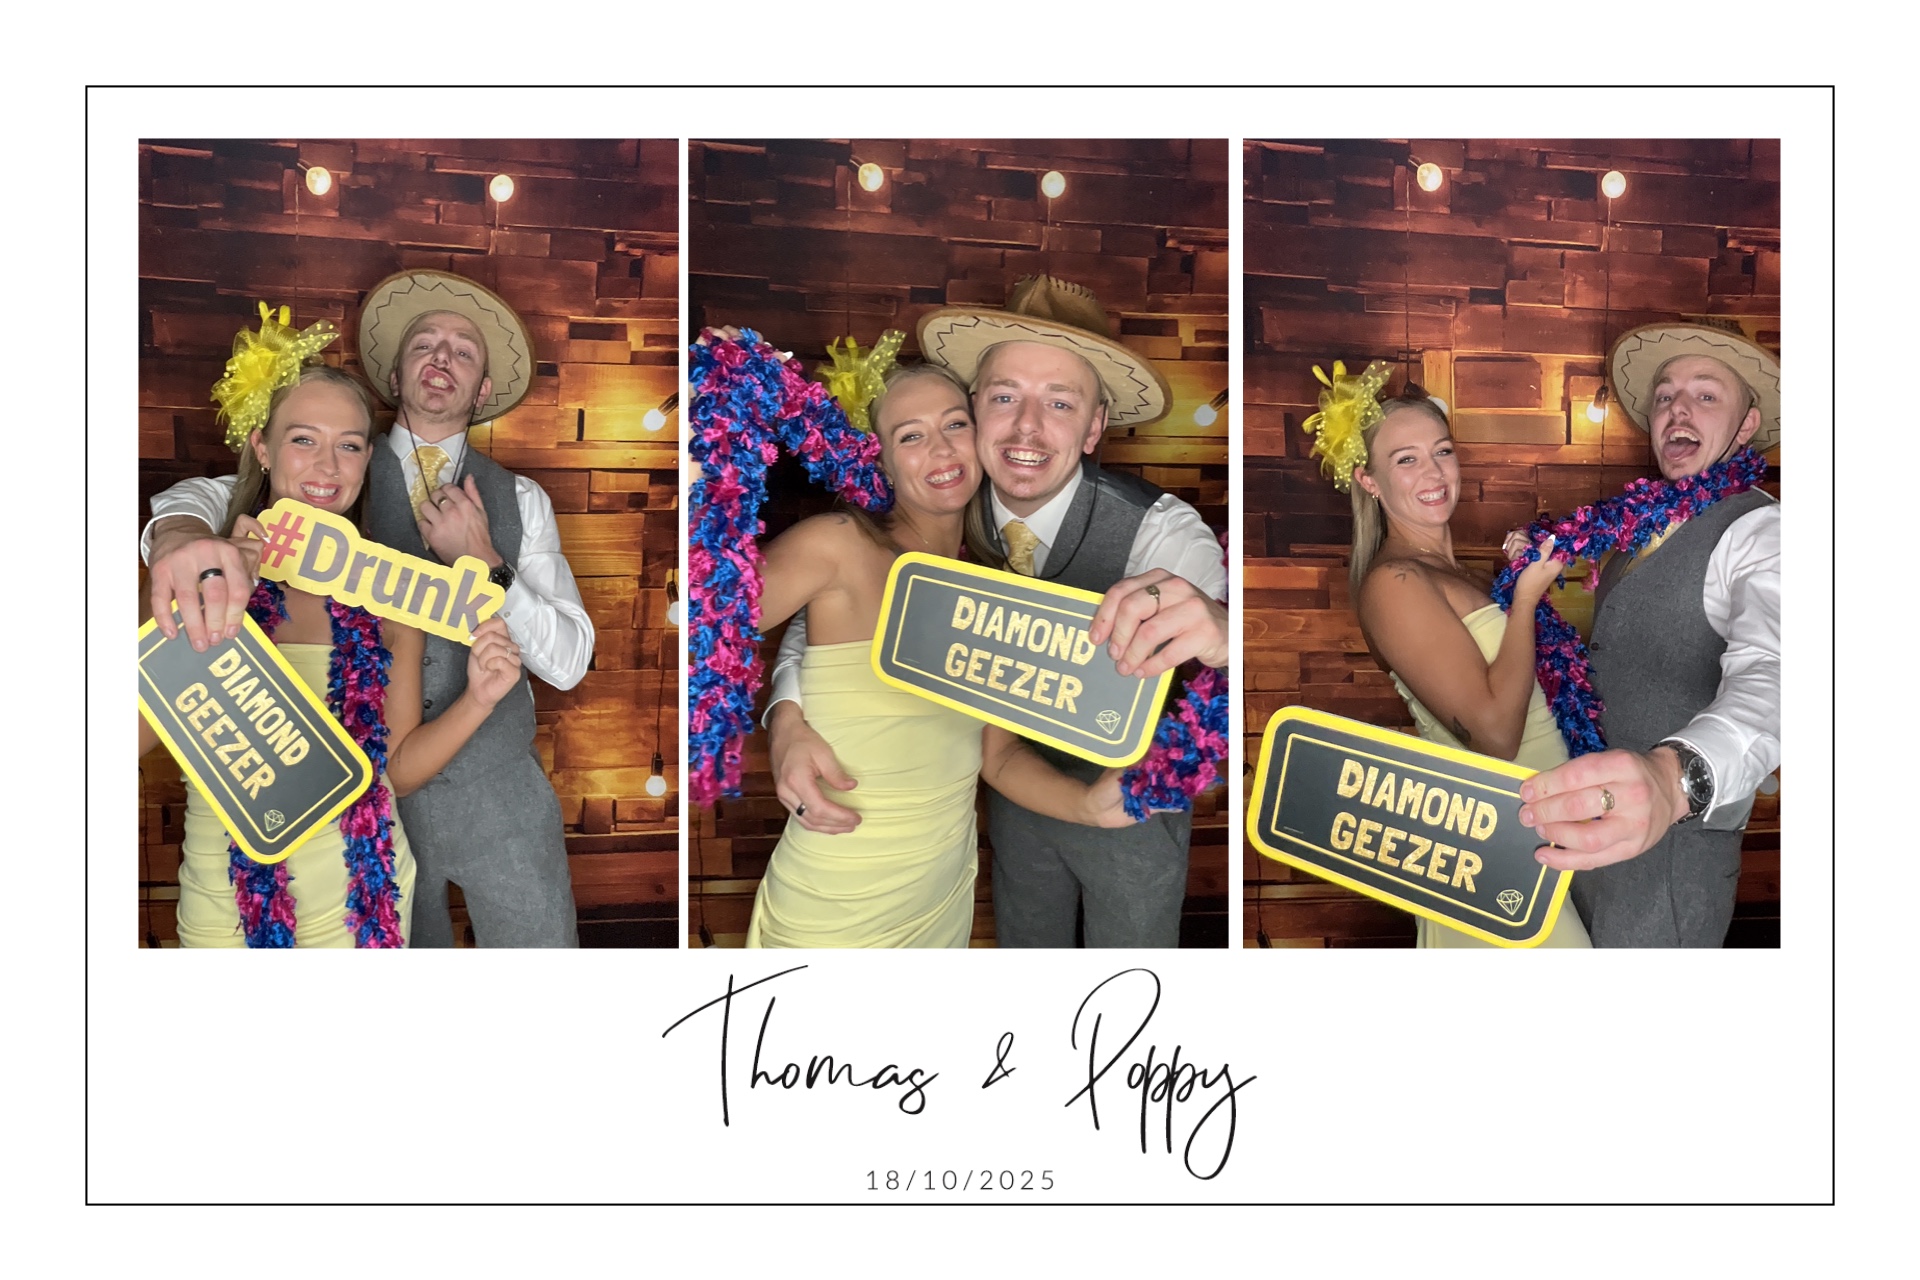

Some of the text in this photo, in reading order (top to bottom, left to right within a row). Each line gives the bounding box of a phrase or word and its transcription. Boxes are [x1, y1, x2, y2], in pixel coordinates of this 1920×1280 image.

[260, 511, 495, 632] #Drunk
[951, 595, 1096, 666] DIAMOND
[207, 647, 311, 766] DIAMOND
[944, 642, 1083, 714] GEEZER
[174, 682, 277, 801] GEEZER
[1336, 758, 1498, 841] DIAMOND
[1330, 811, 1483, 893] GEEZER
